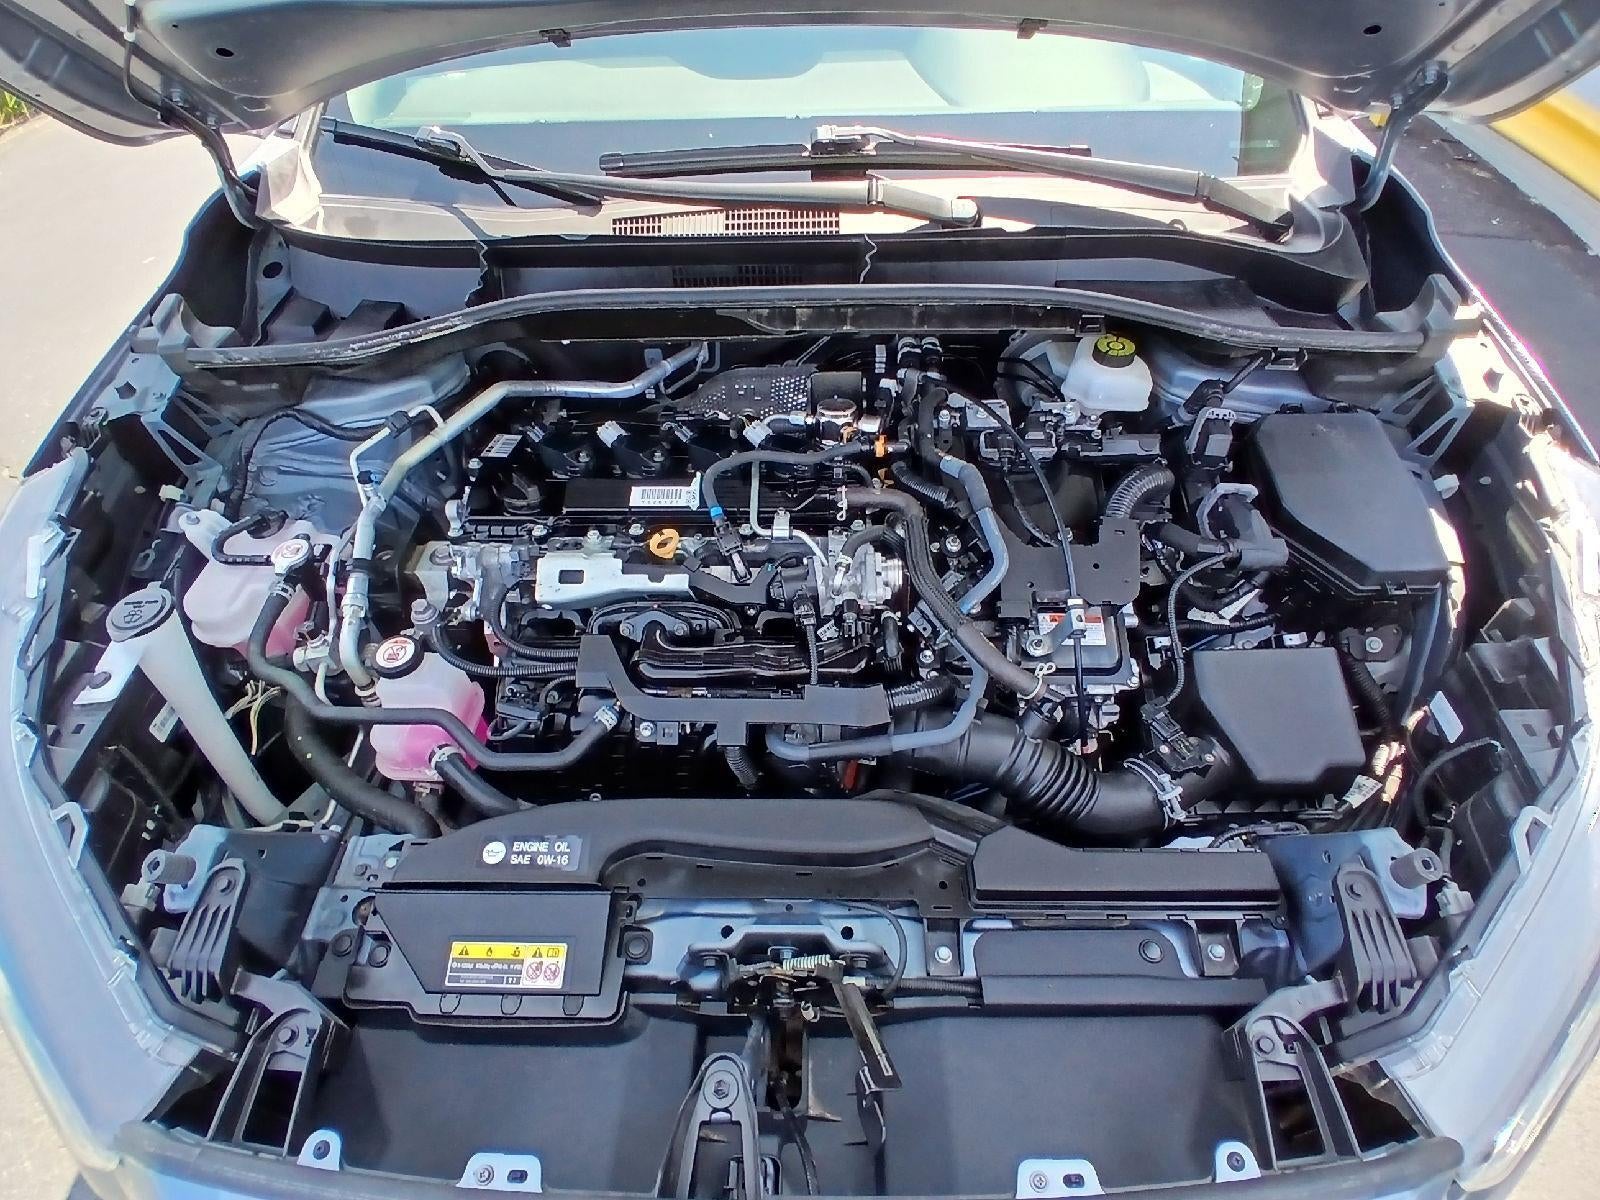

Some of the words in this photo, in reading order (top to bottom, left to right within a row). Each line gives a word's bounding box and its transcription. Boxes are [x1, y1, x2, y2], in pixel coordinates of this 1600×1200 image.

[512, 841, 549, 852] ENGINE
[554, 841, 570, 852] OIL
[510, 854, 531, 864] SAE
[537, 855, 569, 865] 0W-16
